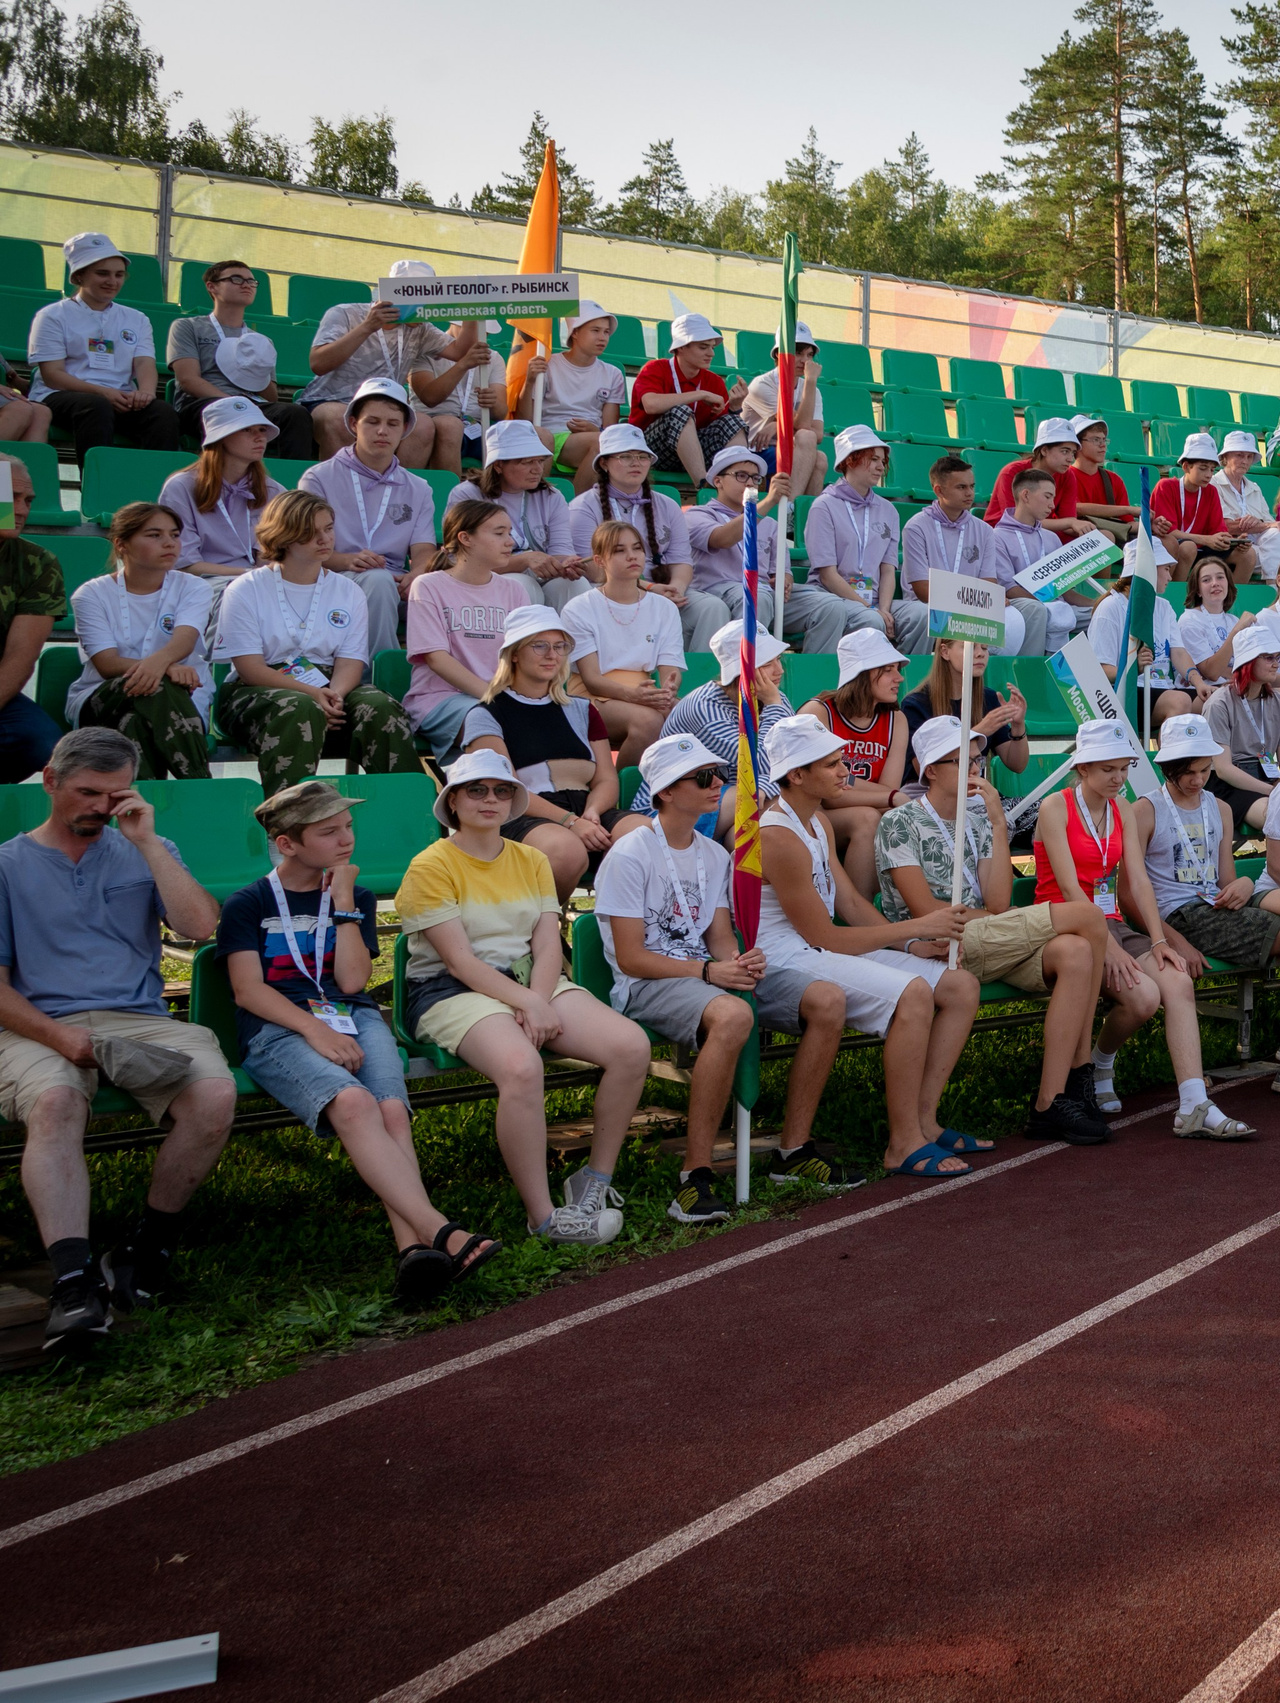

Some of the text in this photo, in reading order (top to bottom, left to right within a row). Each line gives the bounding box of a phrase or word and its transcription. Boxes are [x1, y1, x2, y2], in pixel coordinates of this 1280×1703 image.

[393, 281, 570, 296] «ЮНЫЙ ГЕОЛОГ» г. РЫБИНСК
[416, 304, 548, 319] Ярославская область
[1031, 537, 1101, 582] «СЕРЕБРЯНЫЙ КРАЙ»
[1052, 553, 1111, 591] Забайкальский край
[957, 586, 993, 609] «КАВКАЗИТ»
[947, 615, 998, 641] Краснодарский край
